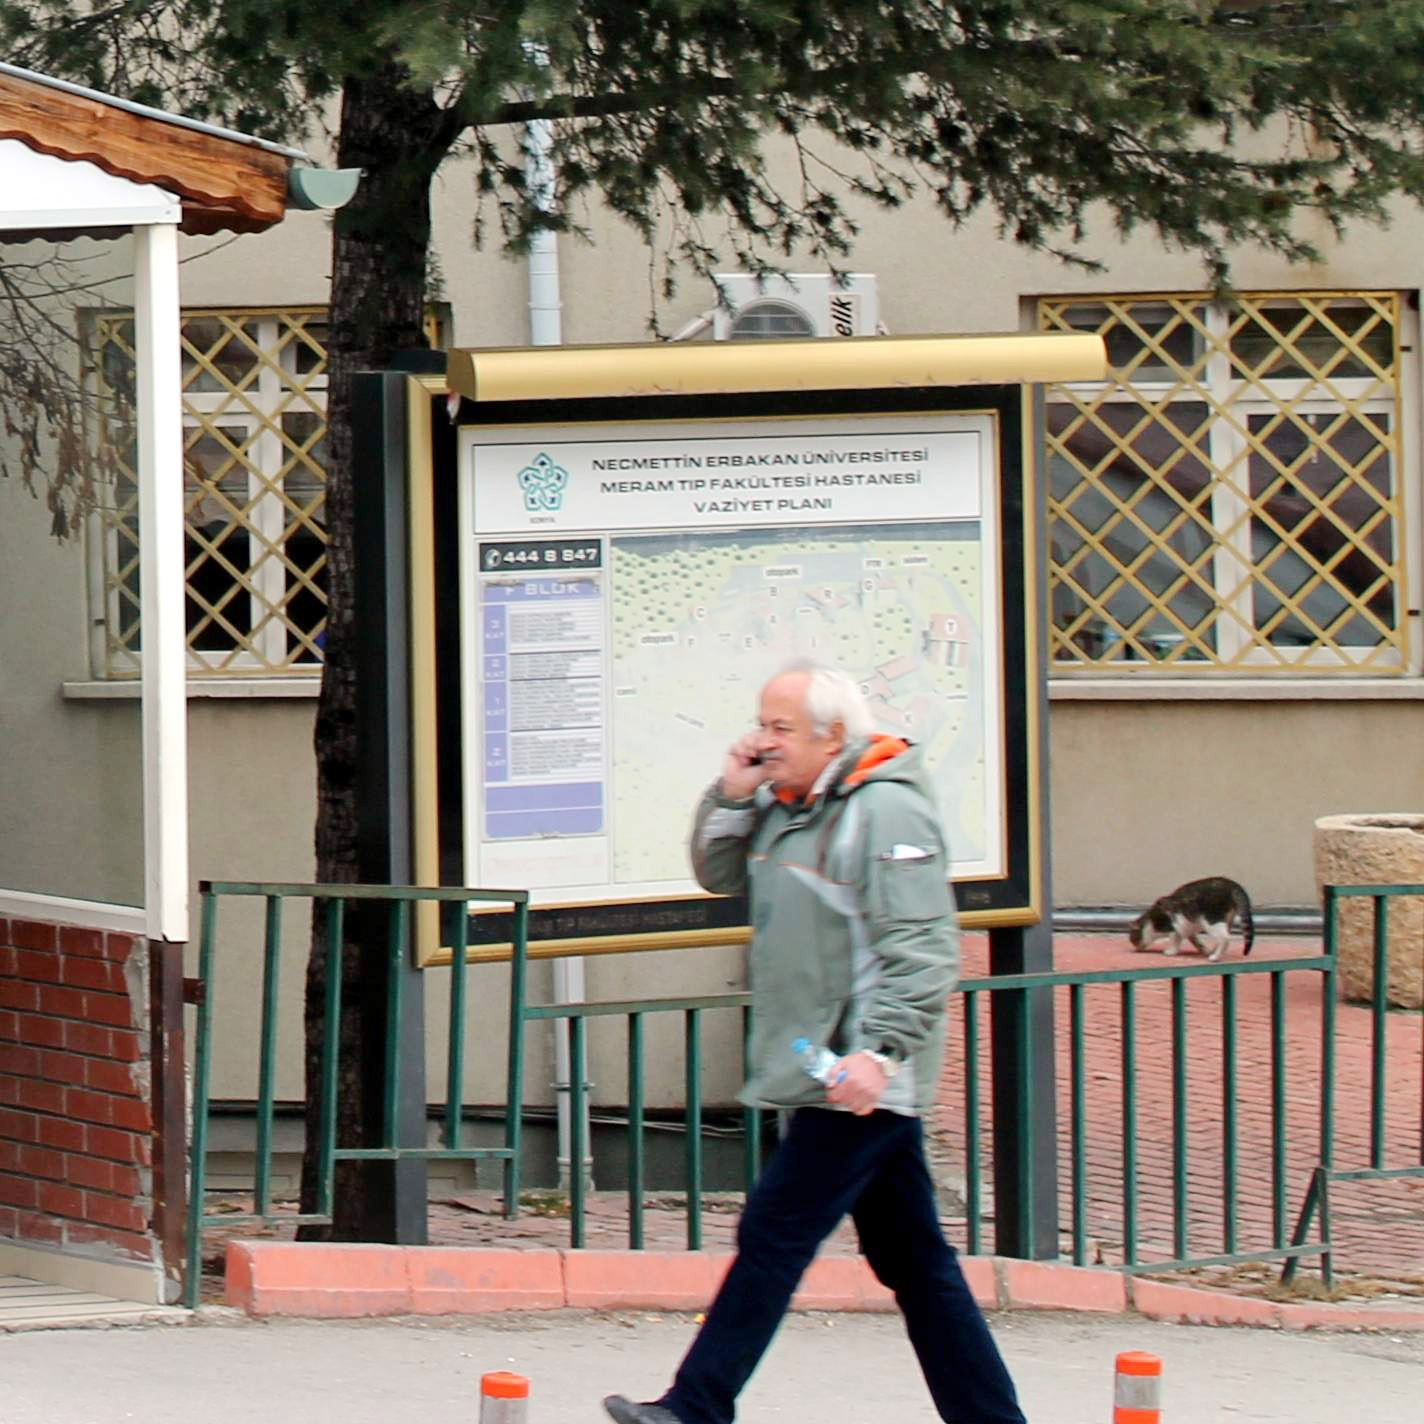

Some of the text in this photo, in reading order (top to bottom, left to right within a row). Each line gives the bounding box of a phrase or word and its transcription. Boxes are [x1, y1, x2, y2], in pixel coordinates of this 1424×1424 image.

[592, 448, 929, 471] NECMETTİN ERBAKAN ÜNİVERSİTESİ
[601, 470, 921, 493] MERAM TIP FAKÜLTESİ HASTANESİ
[694, 498, 832, 513] VAZİYET PLANI
[503, 550, 539, 563] 444
